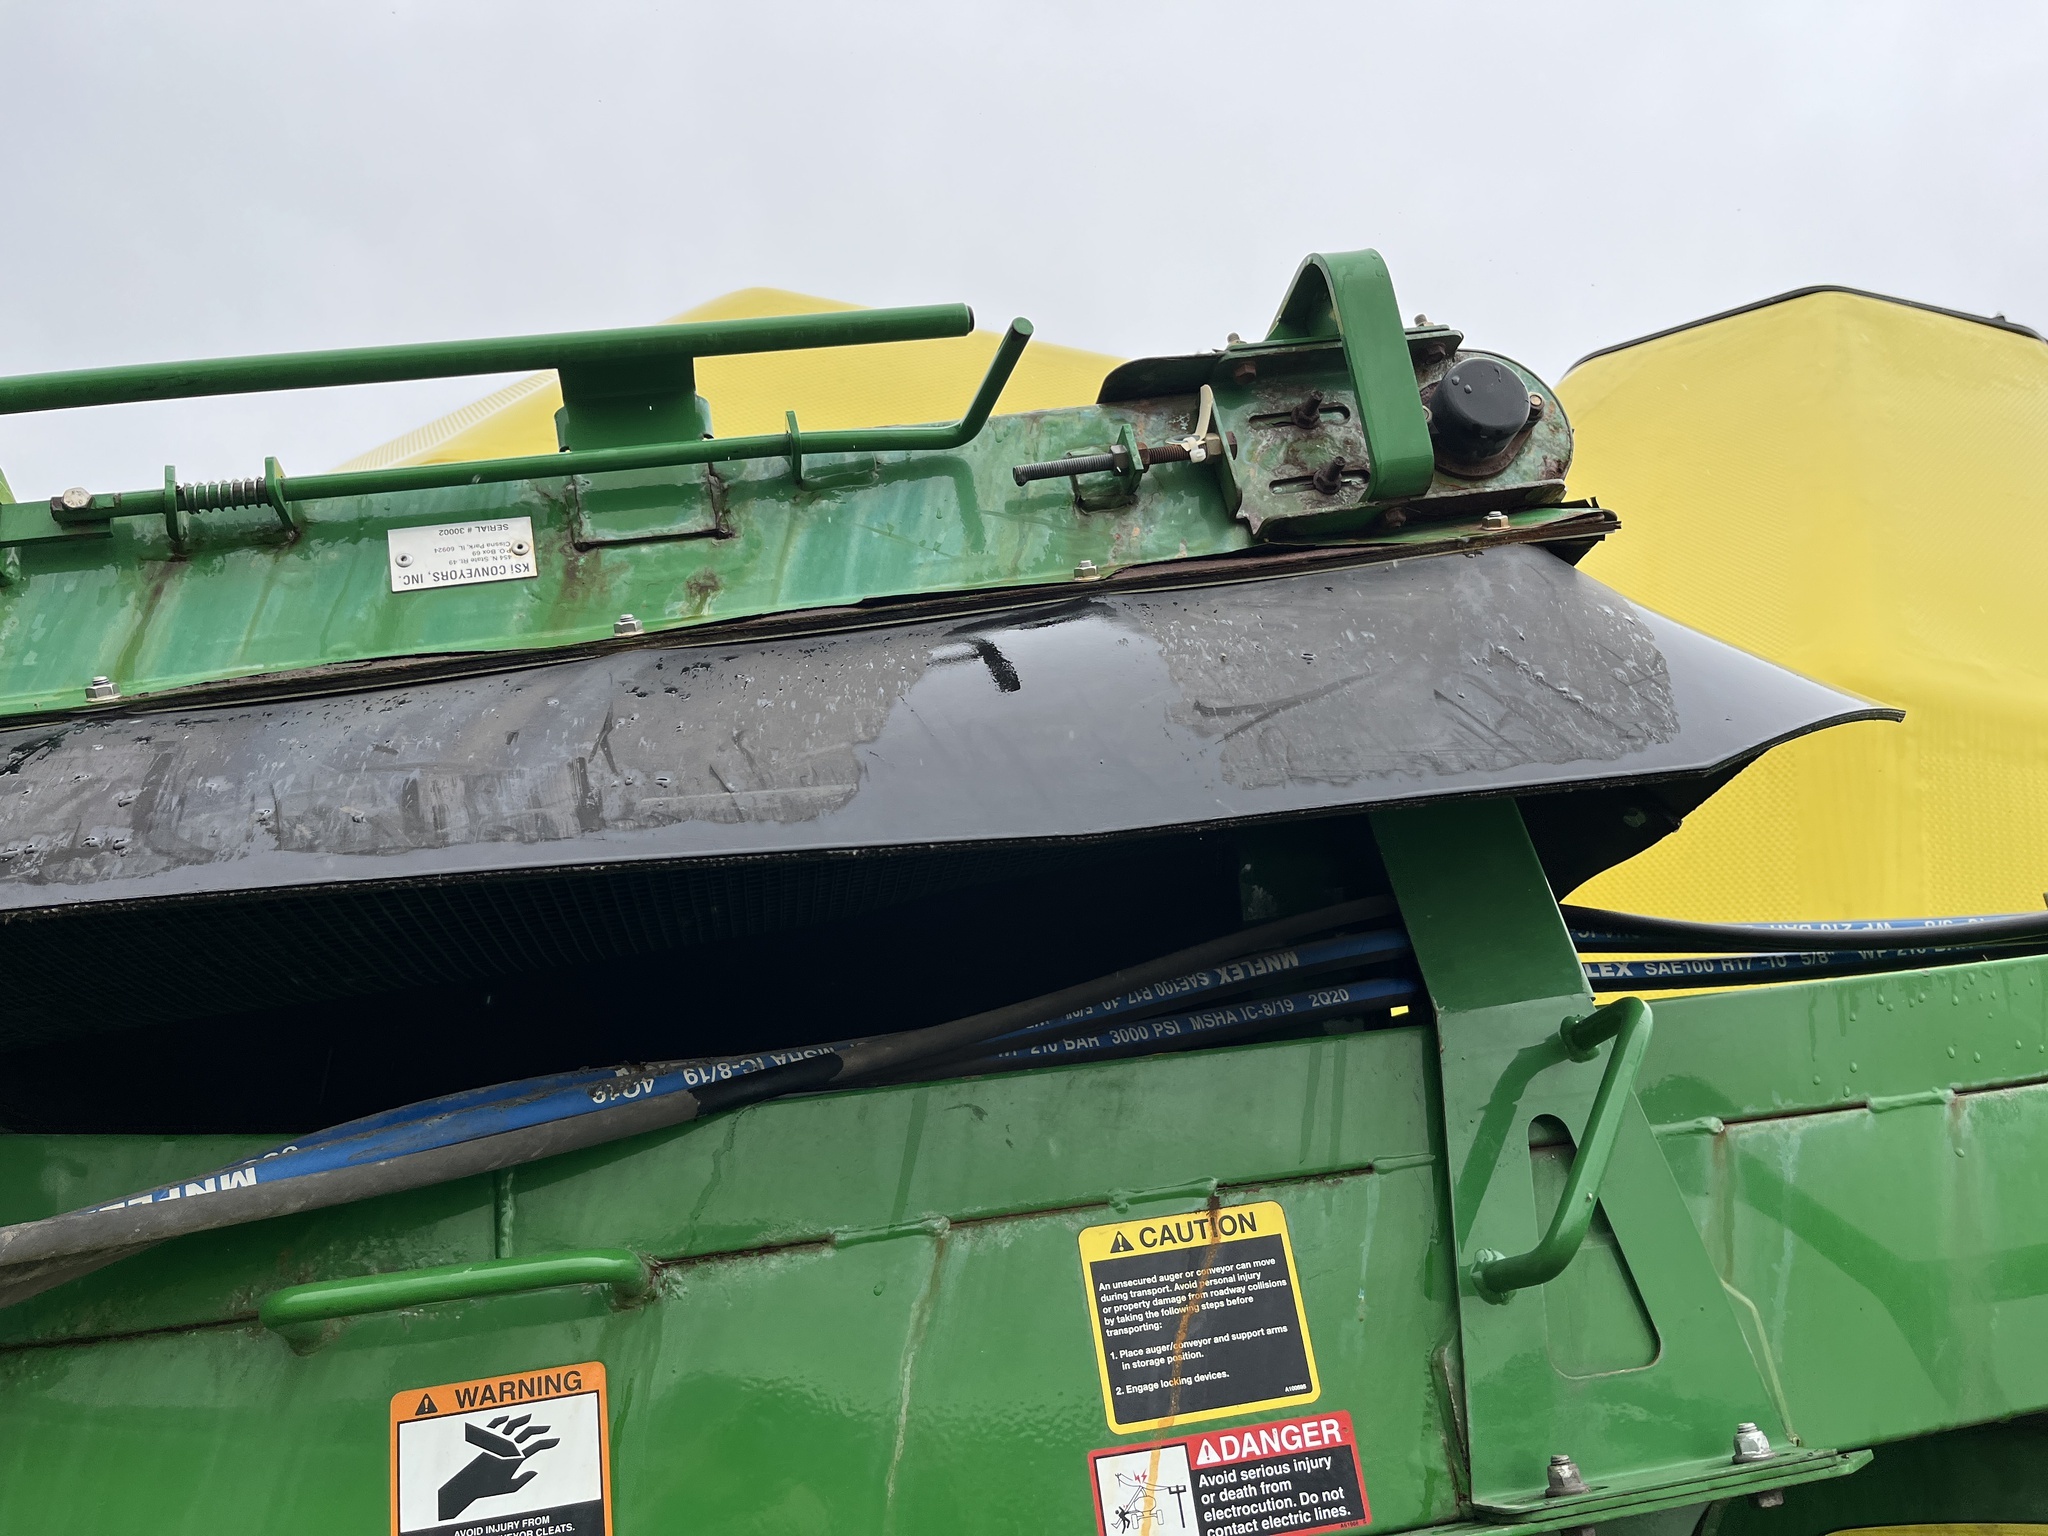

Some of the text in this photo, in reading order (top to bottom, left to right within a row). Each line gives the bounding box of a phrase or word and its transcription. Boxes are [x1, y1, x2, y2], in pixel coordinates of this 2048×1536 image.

[438, 528, 465, 536] 30002
[475, 524, 509, 532] SERIAL
[399, 563, 530, 586] KSi CONVEYORS, INC.
[1214, 951, 1298, 984] MNFLEX
[1644, 959, 1714, 976] SAE100
[1720, 956, 1751, 972] R17
[1128, 987, 1153, 1004] R17
[1154, 972, 1210, 997] SAE100
[1109, 1026, 1149, 1044] 3000
[1154, 1020, 1180, 1038] PSI
[1188, 1010, 1238, 1030] MSHA
[1240, 999, 1294, 1021] IC-8/19
[1308, 988, 1350, 1008] 2Q20
[682, 1057, 766, 1086] IC-8/19
[1139, 1212, 1258, 1248] CAUTION
[1098, 1258, 1276, 1292] An unsecured auger or conveyor can move
[1100, 1271, 1261, 1302] during transport. Avoid personal injury
[1102, 1278, 1287, 1314] or property damage from roadway collisions
[1104, 1295, 1254, 1326] by taking the following steps before
[1106, 1322, 1162, 1337] transporting:
[1110, 1325, 1288, 1360] 1. Place auger/conveyor and support arms
[1122, 1351, 1204, 1370] in storage position.
[455, 1370, 582, 1409] WARNING
[1116, 1371, 1230, 1396] 2. Engage locking devices.
[1219, 1418, 1342, 1461] DANGER
[1199, 1456, 1331, 1488] Avoid serious injury
[1201, 1480, 1292, 1505] or death from
[1204, 1486, 1344, 1522] electrocution. Do not
[454, 1526, 483, 1536] AVOID
[486, 1521, 520, 1534] INJURY
[522, 1515, 550, 1528] FROM
[535, 1523, 575, 1536] CLEATS.
[1207, 1505, 1351, 1536] contact electric lines.
